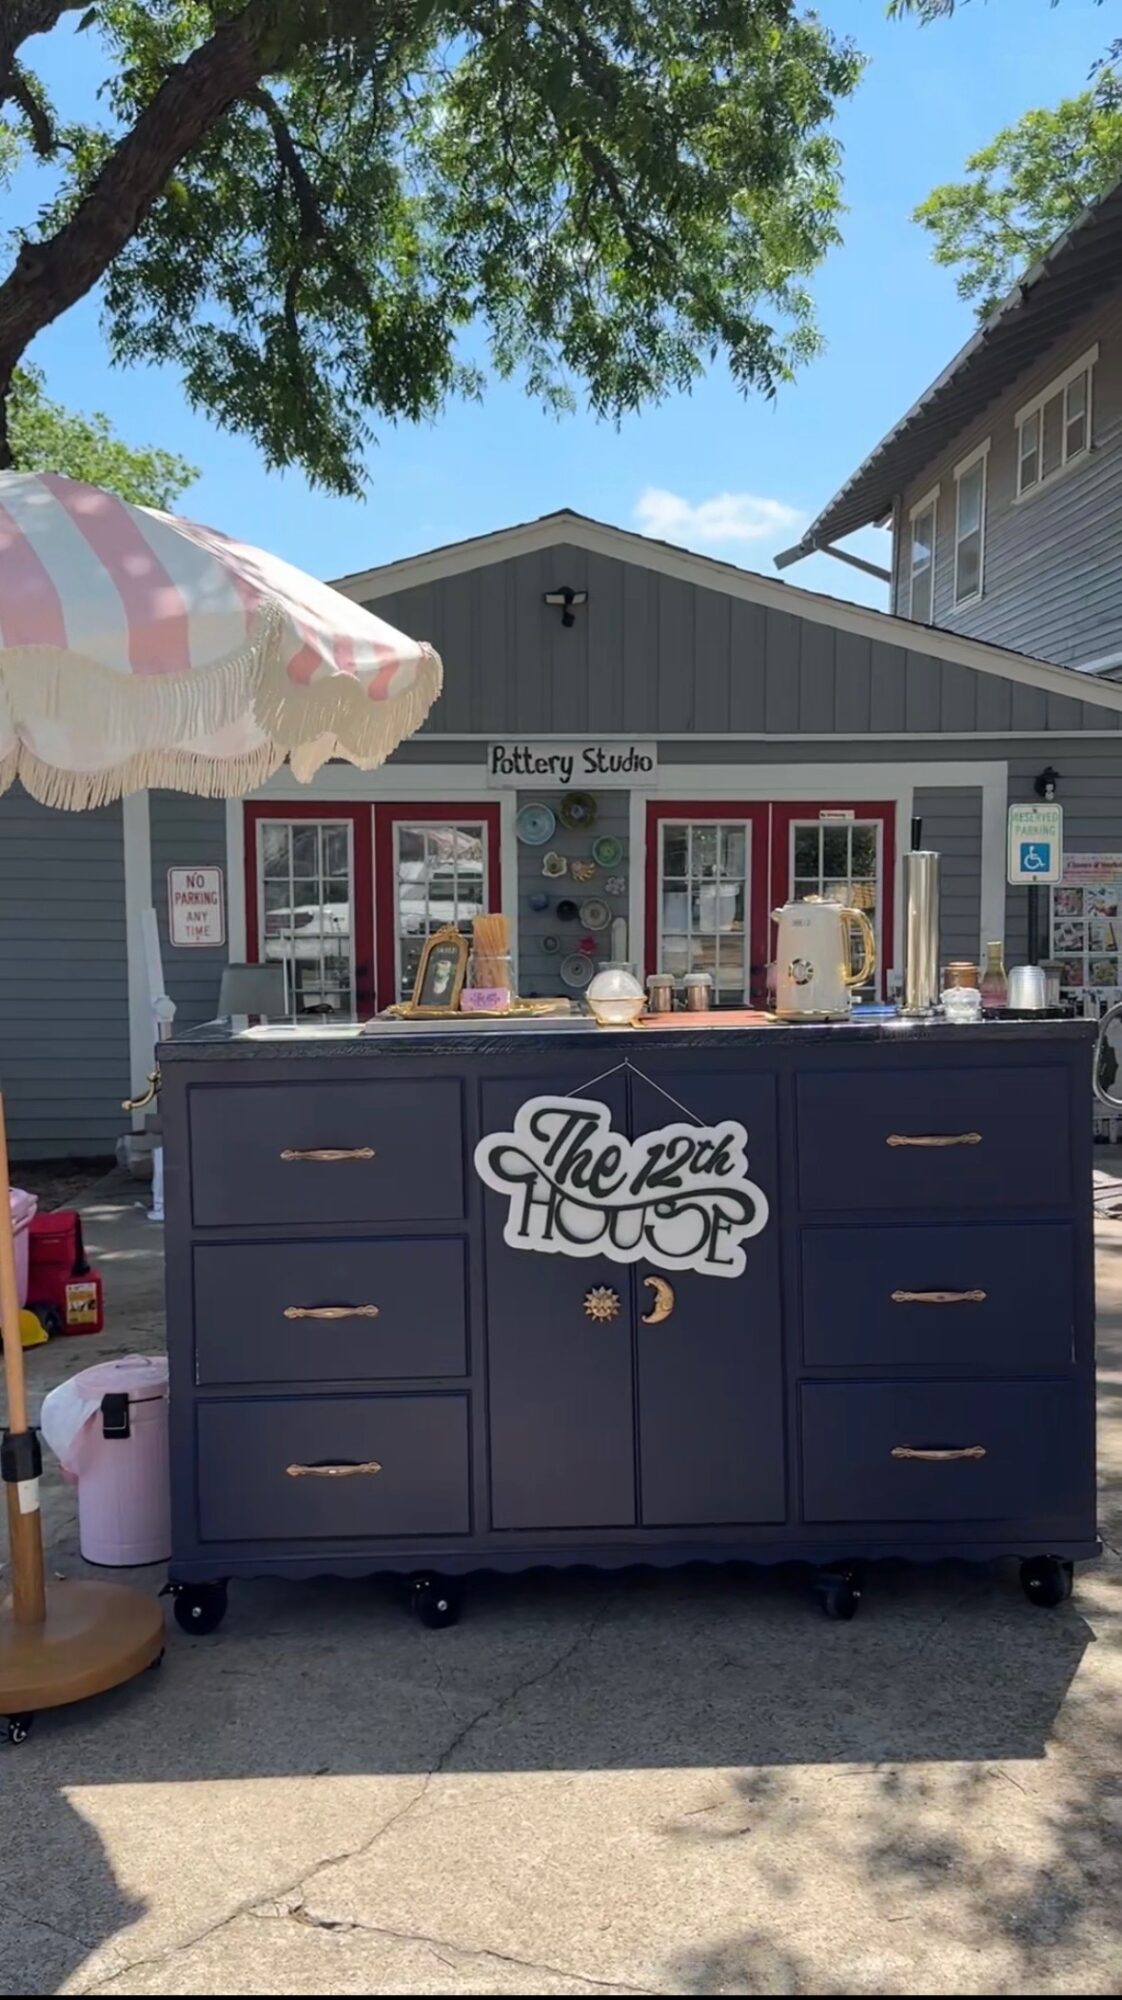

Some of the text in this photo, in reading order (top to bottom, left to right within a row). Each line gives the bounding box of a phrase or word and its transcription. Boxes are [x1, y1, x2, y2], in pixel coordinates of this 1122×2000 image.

[492, 745, 653, 784] Pottery Studio
[1012, 811, 1058, 823] RESERVED
[1015, 824, 1056, 836] PARKING
[186, 874, 205, 889] NO
[175, 891, 218, 906] PARKING
[186, 911, 208, 922] ANY
[185, 924, 211, 937] TIME
[530, 1108, 735, 1198] The 12th
[488, 1146, 756, 1266] HOUSE
